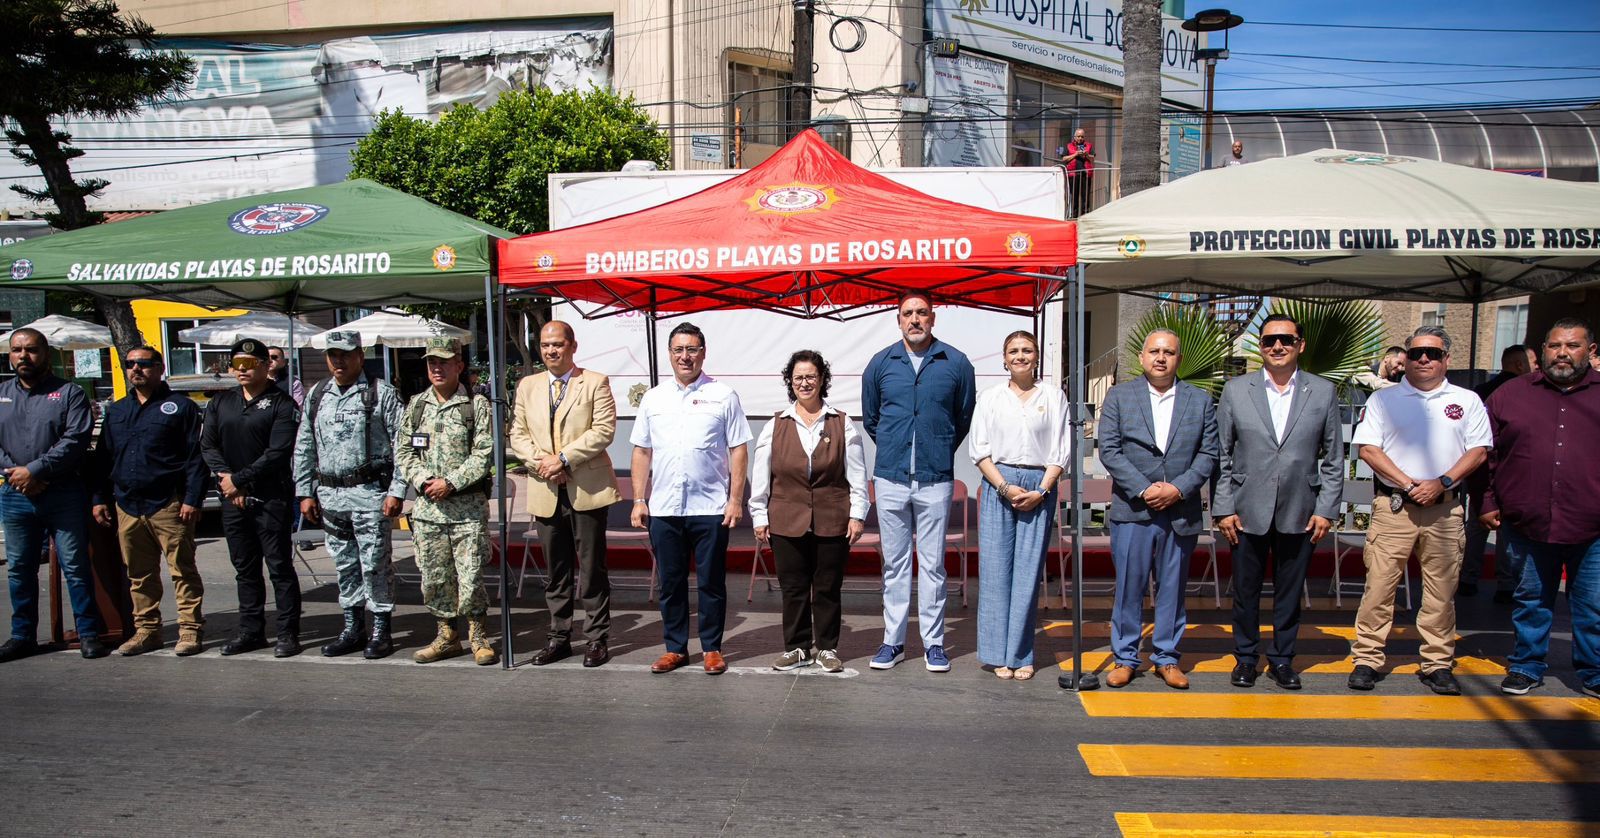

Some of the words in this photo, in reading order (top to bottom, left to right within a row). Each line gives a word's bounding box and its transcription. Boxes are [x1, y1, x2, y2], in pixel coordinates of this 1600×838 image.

[974, 58, 1005, 75] BONANOVA
[1012, 41, 1048, 56] servicio
[1057, 53, 1125, 77] profesionalismo
[193, 56, 263, 98] AL
[935, 70, 946, 78] OPEN
[974, 79, 991, 88] ABIERTO
[1189, 229, 1331, 251] PROTECCION
[1339, 229, 1399, 250] CIVIL
[1406, 228, 1497, 249] PLAYAS
[1504, 228, 1536, 249] DE
[66, 262, 180, 281] SALVAVIDAS
[184, 258, 256, 279] PLAYAS
[259, 257, 288, 277] DE
[291, 252, 391, 276] ROSARITO
[585, 247, 709, 275] BOMBEROS
[716, 244, 803, 269] PLAYAS
[810, 242, 841, 264] DE
[847, 237, 972, 262] ROSARITO
